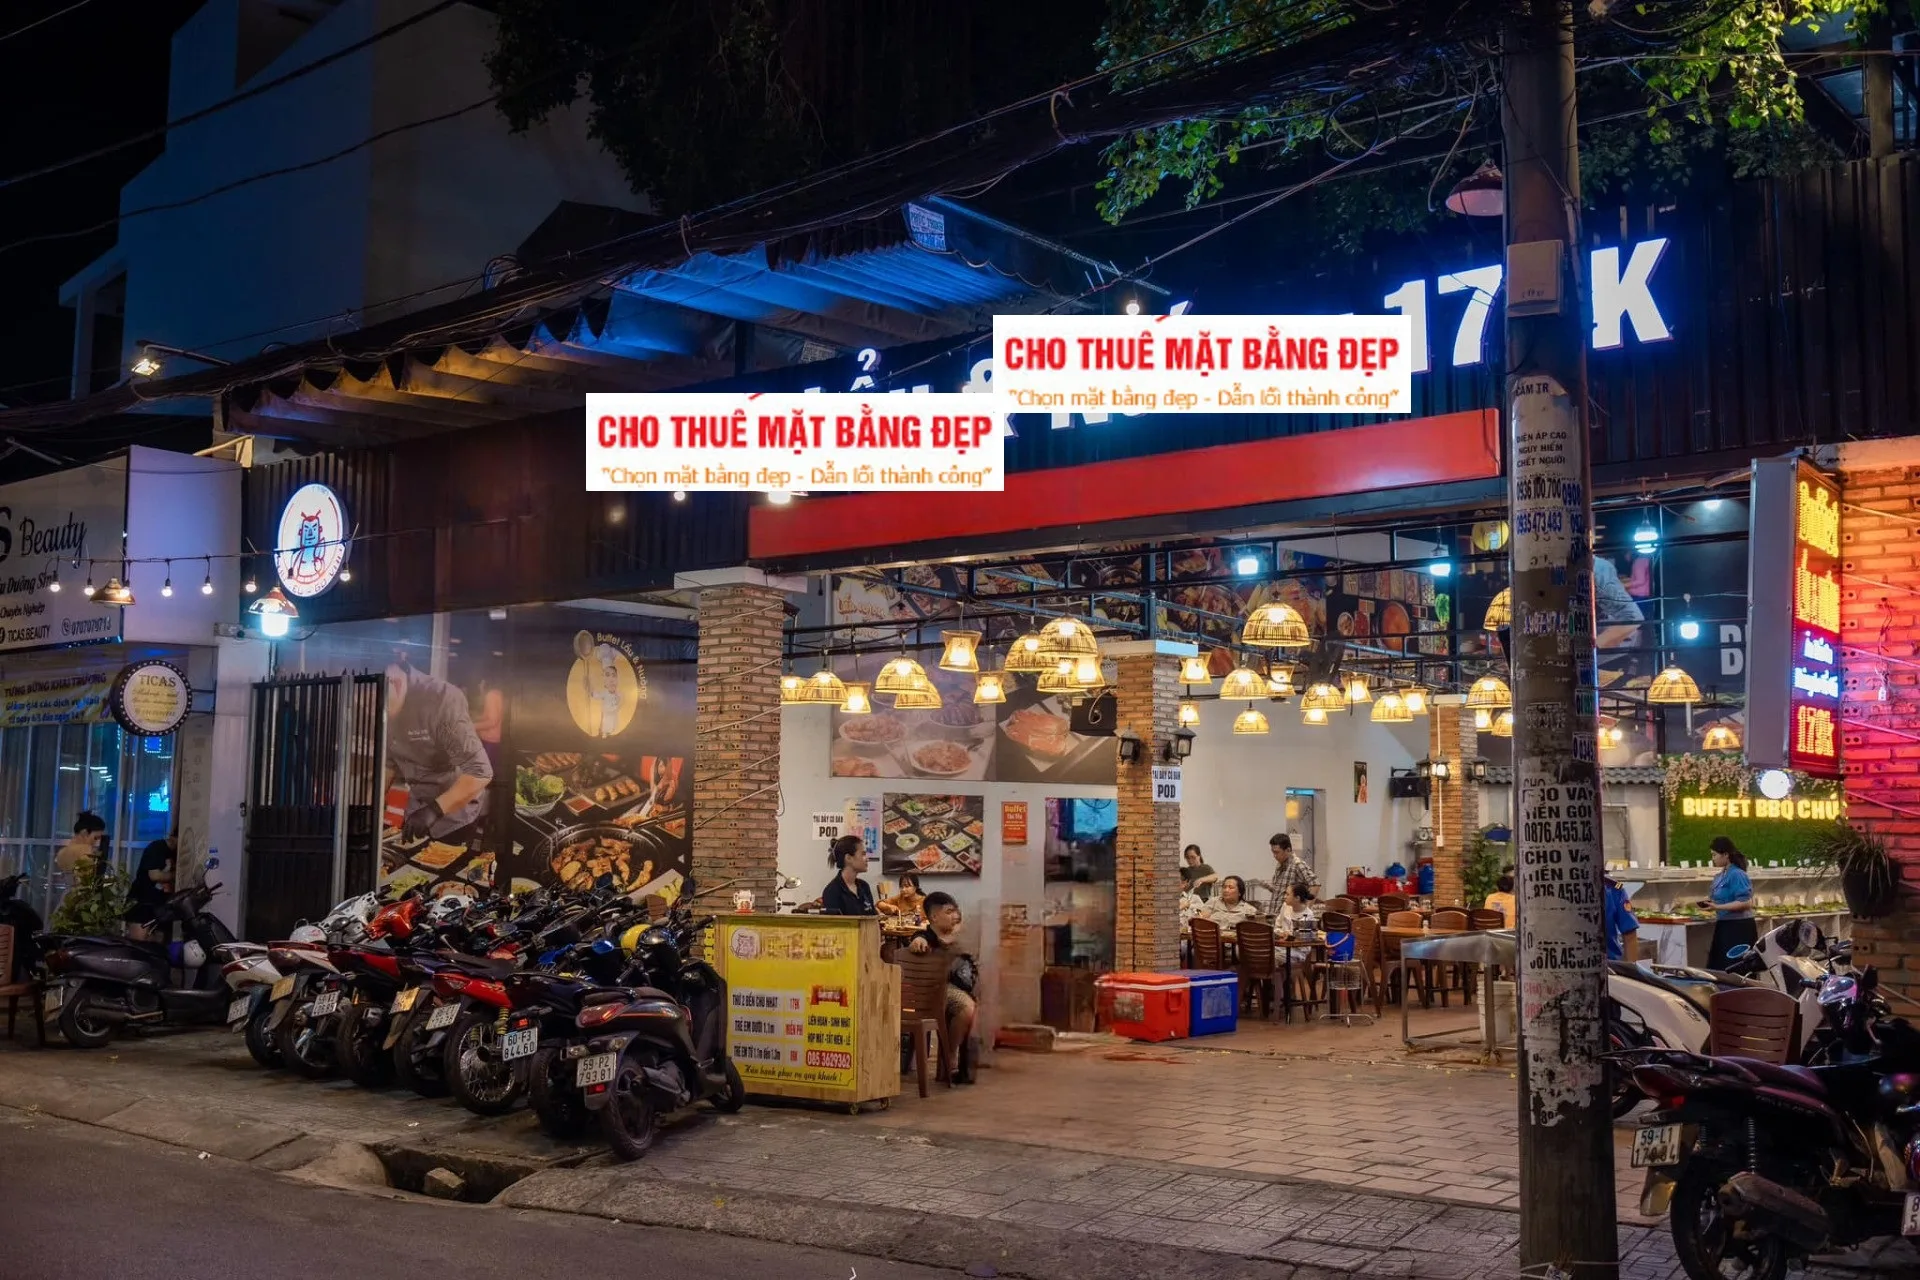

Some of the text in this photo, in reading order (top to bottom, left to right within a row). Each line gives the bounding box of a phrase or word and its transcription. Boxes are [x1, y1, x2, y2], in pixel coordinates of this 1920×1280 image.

[19, 511, 88, 570] Beauty
[7, 623, 51, 643] TICAS.BEAUTY
[139, 674, 177, 688] TICAS
[1157, 783, 1176, 799] POD
[1682, 797, 1751, 818] BUFFET
[1755, 799, 1794, 821] BBQ
[819, 826, 838, 837] POD
[1525, 850, 1562, 865] CHO
[1640, 1127, 1673, 1146] 59-L1
